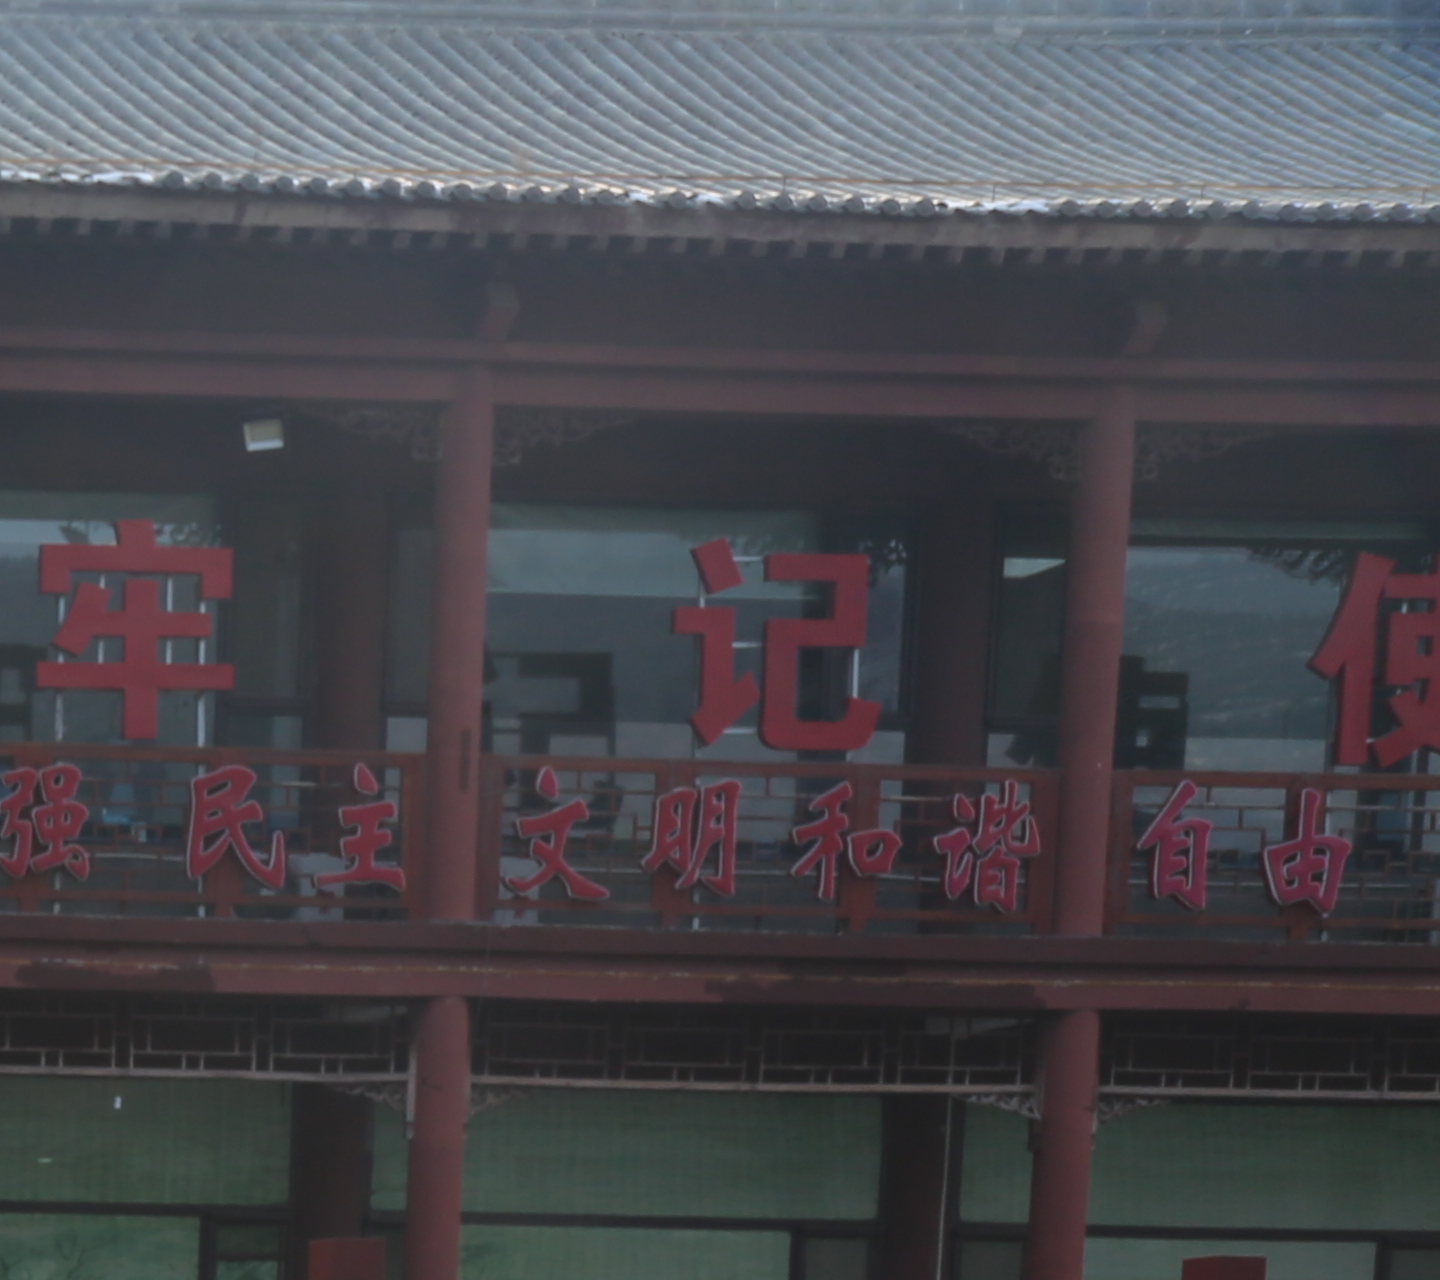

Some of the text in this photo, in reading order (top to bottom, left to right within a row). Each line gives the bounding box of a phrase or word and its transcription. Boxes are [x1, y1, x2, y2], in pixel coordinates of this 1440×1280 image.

[36, 519, 235, 739] 牢
[670, 537, 880, 751] 记
[1137, 778, 1352, 914] 自由
